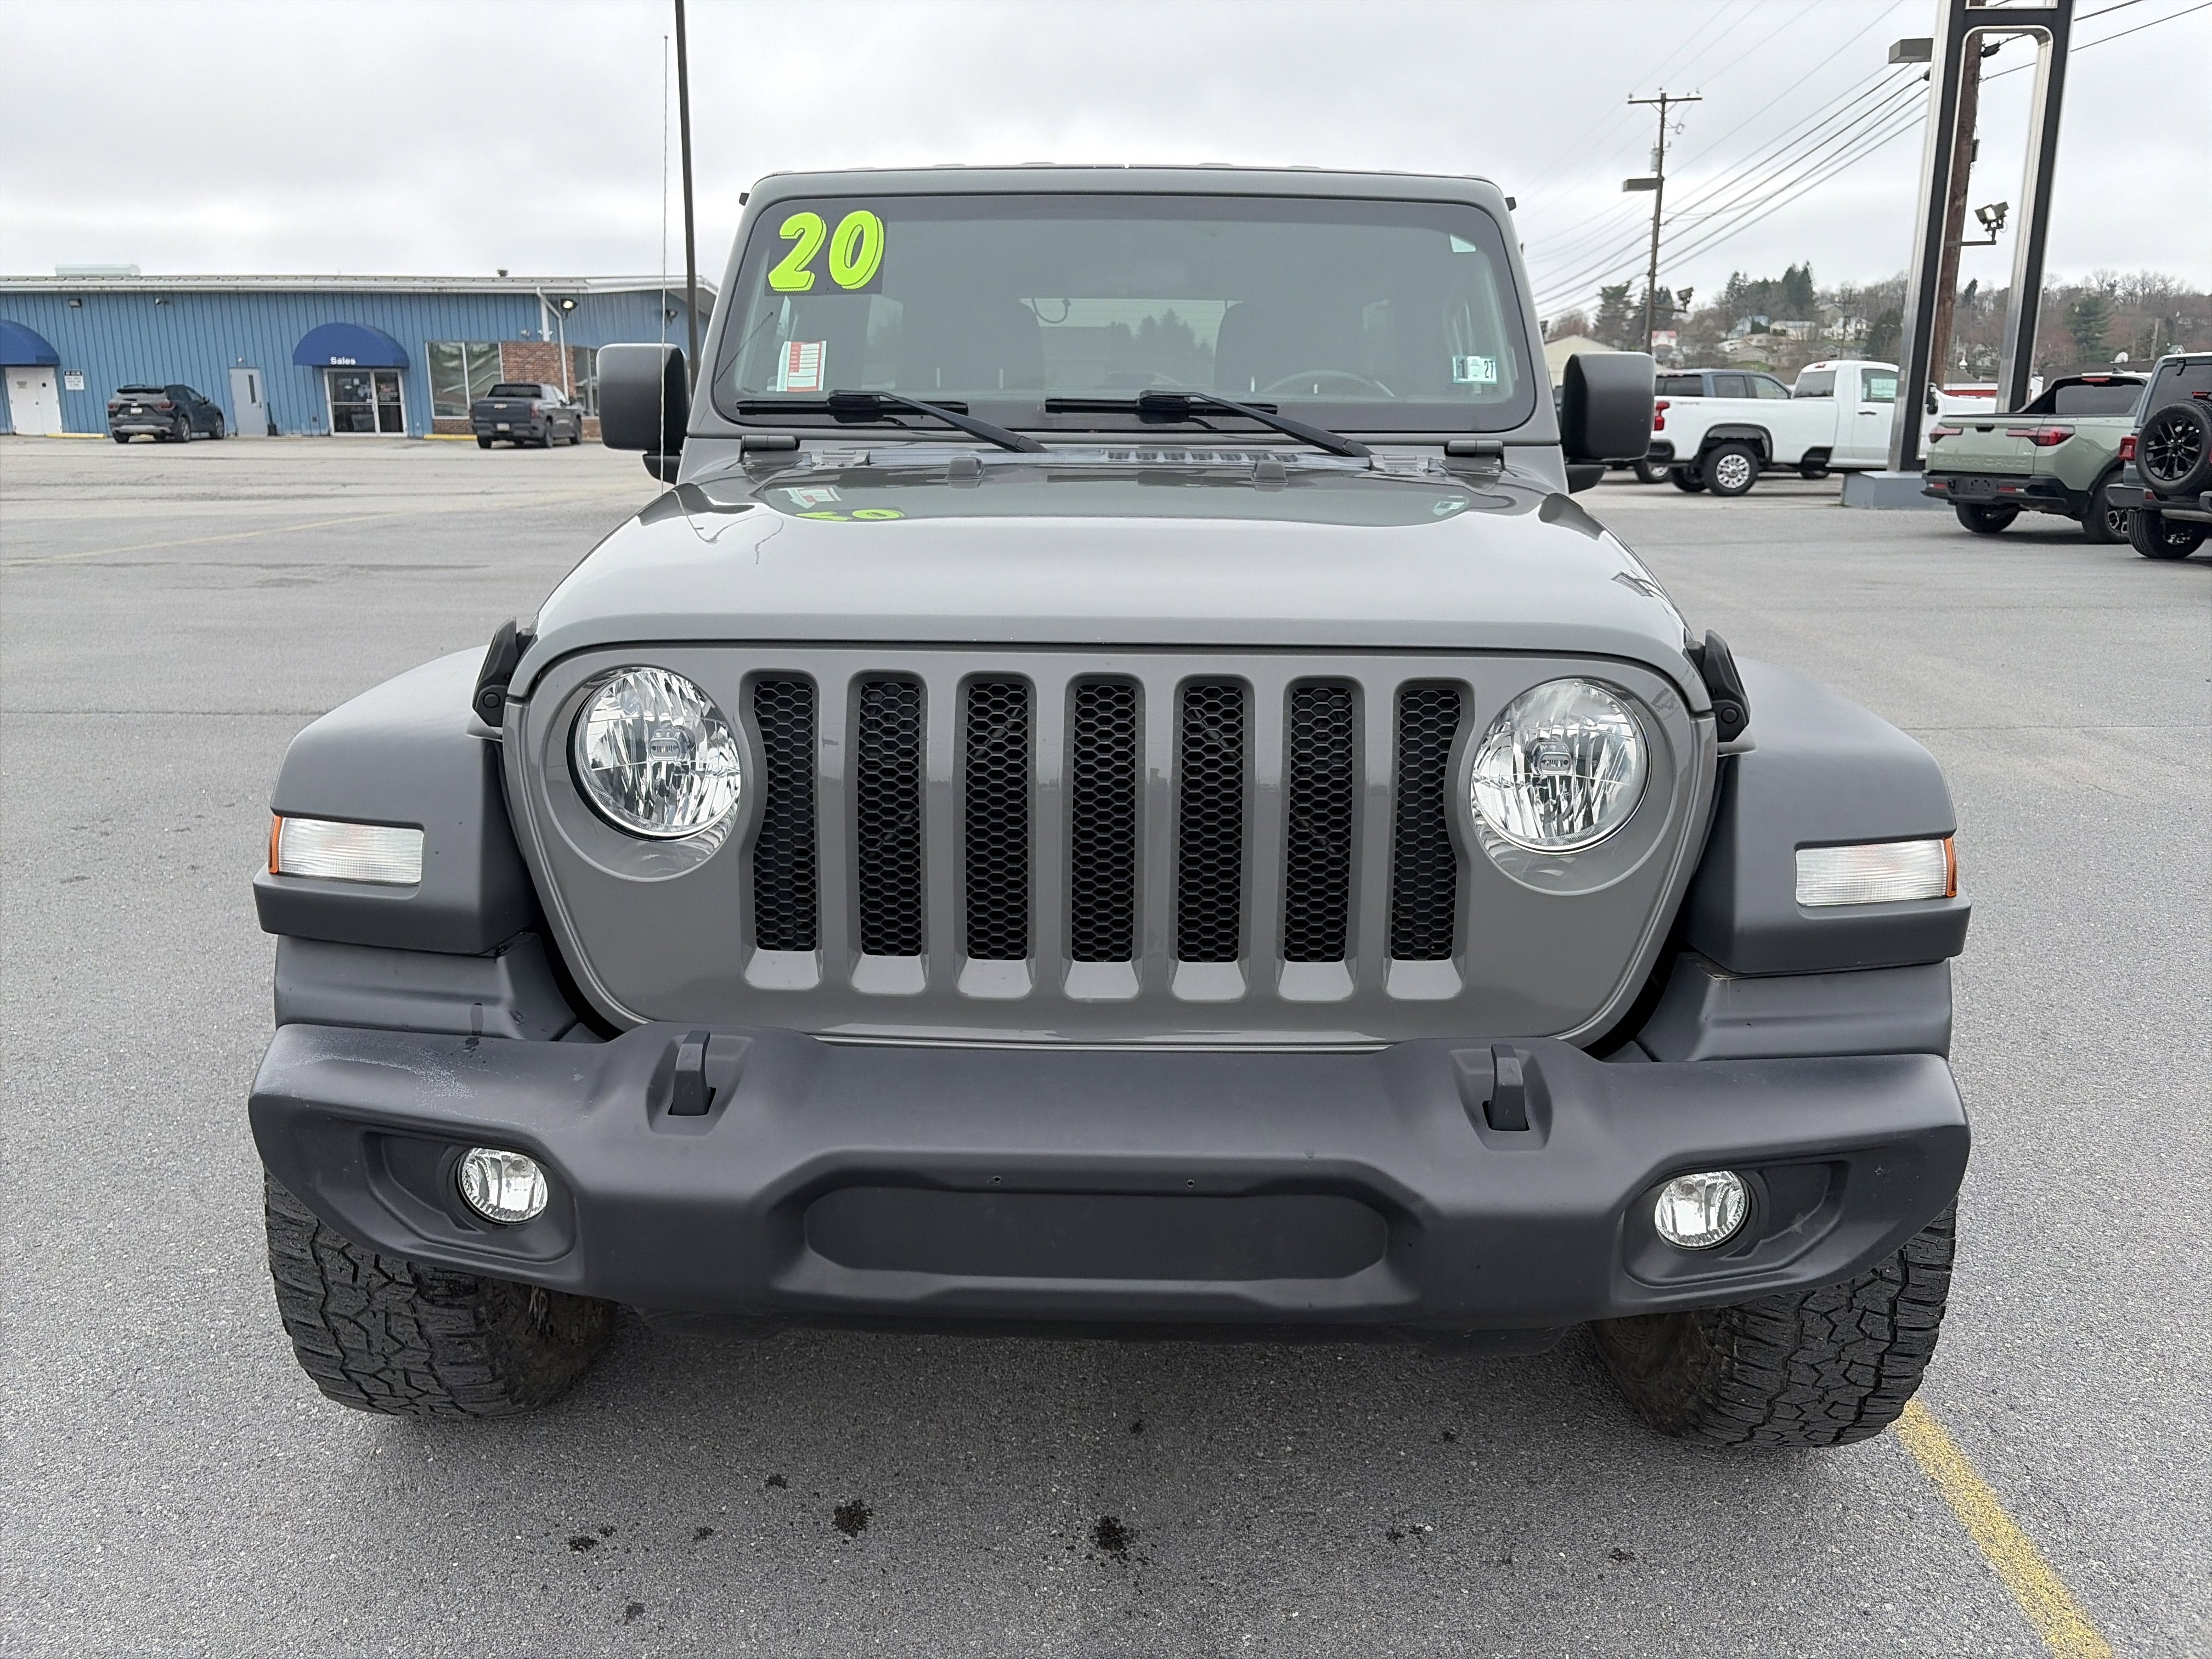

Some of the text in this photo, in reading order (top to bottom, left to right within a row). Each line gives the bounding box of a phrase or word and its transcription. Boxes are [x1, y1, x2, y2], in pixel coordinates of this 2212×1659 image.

[768, 210, 884, 292] 20
[330, 356, 356, 365] Sales
[1484, 360, 1493, 380] 27
